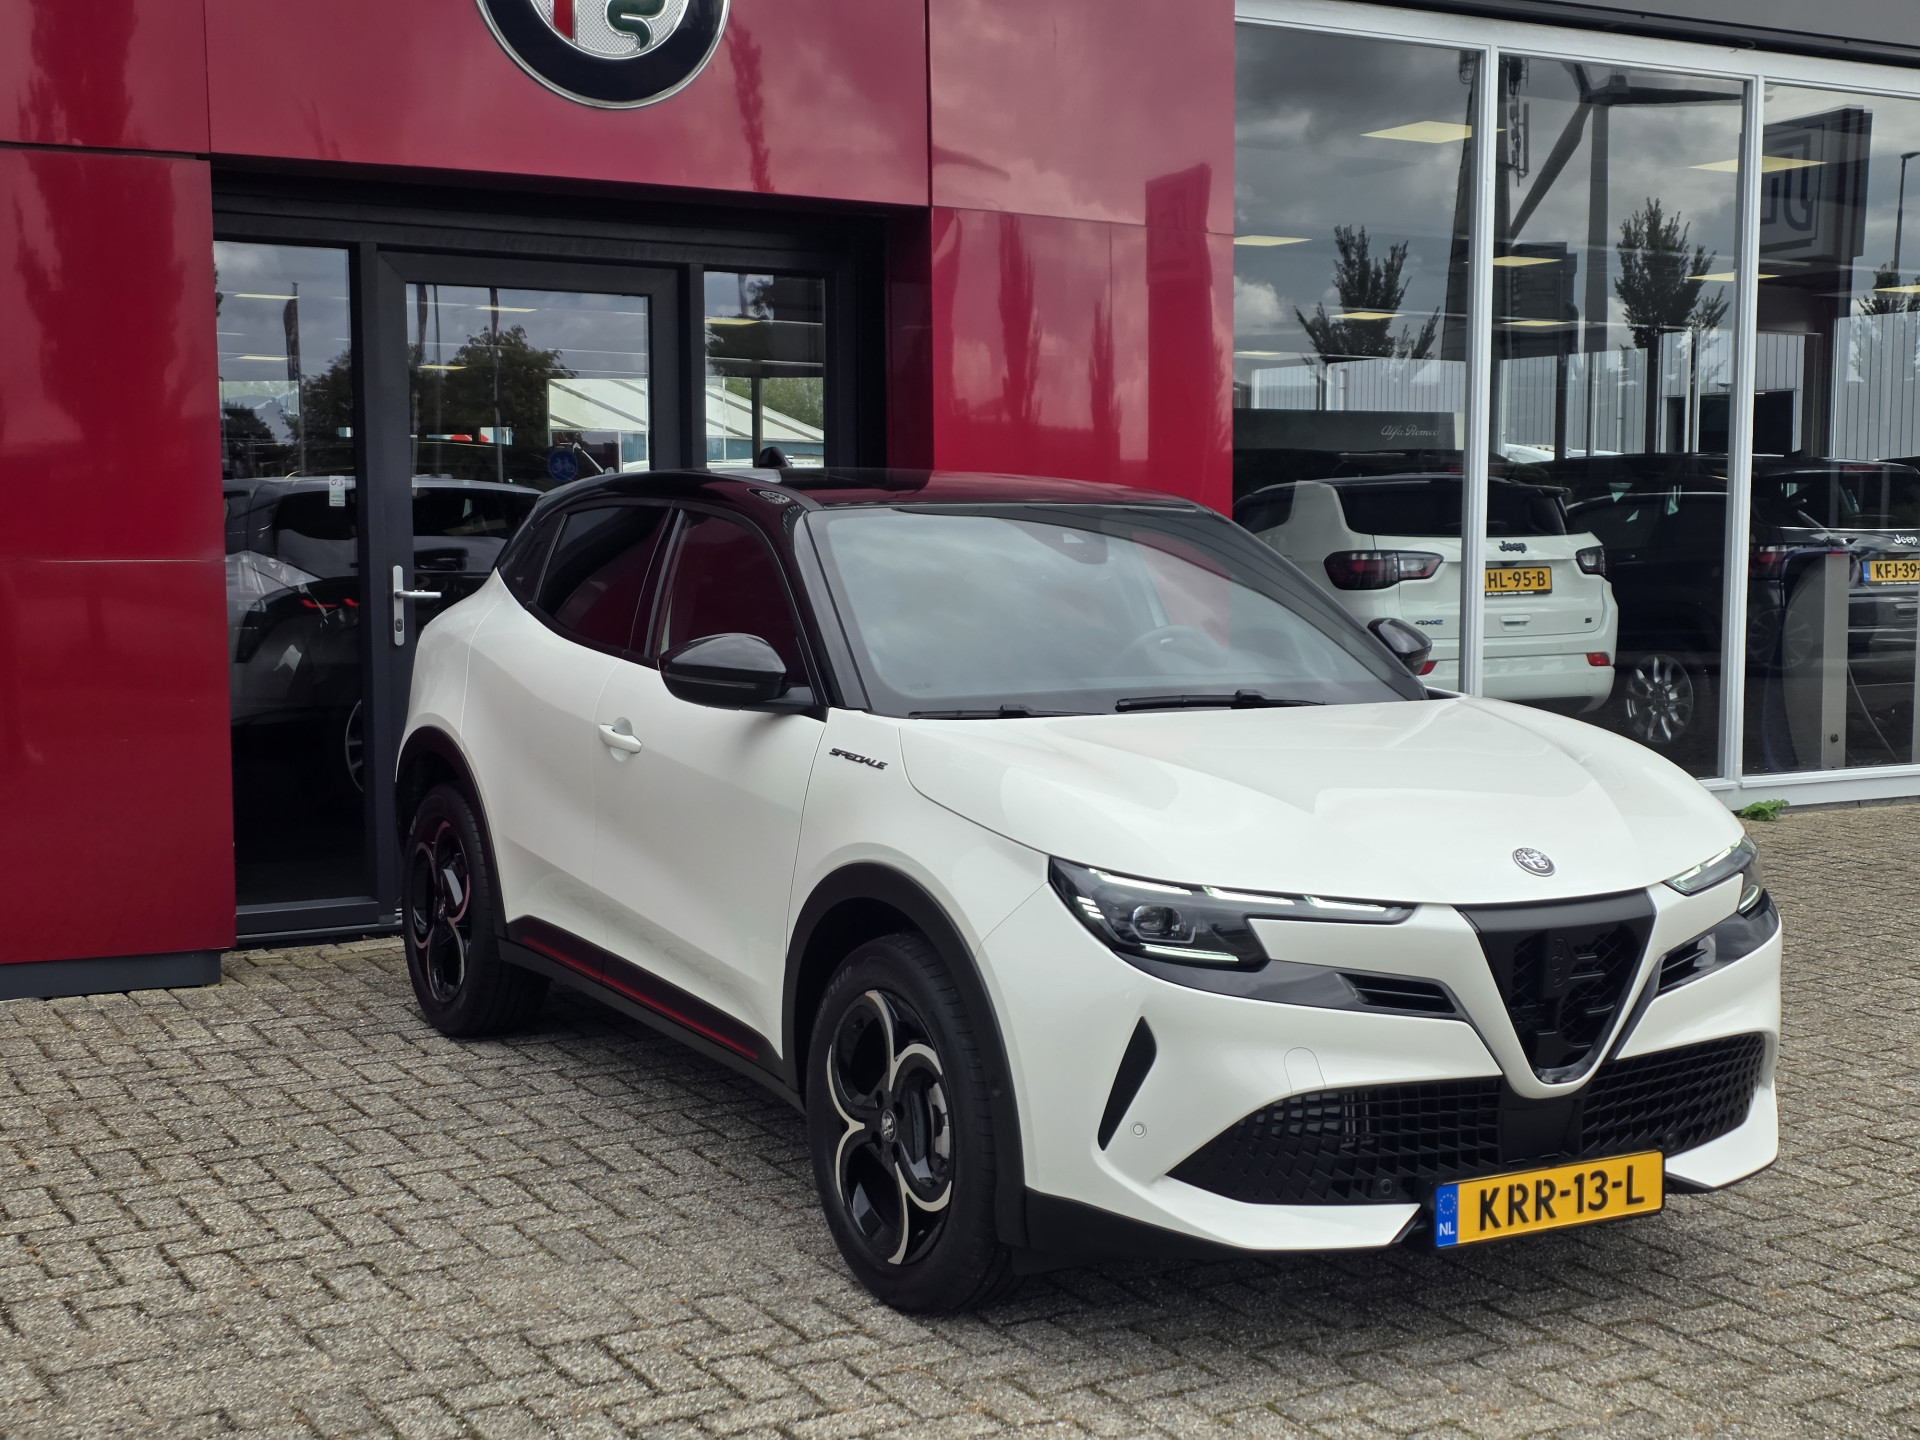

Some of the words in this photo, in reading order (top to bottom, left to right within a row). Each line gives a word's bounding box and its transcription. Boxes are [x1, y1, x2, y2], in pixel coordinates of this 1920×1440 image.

[1381, 424, 1404, 440] Alfa
[1499, 540, 1527, 553] Jeep
[1894, 534, 1917, 545] Jeep
[1485, 570, 1546, 589] HL-95-B
[828, 747, 889, 771] SPECIALE
[1479, 1164, 1646, 1232] KRR-13-L
[1438, 1220, 1456, 1237] NL
